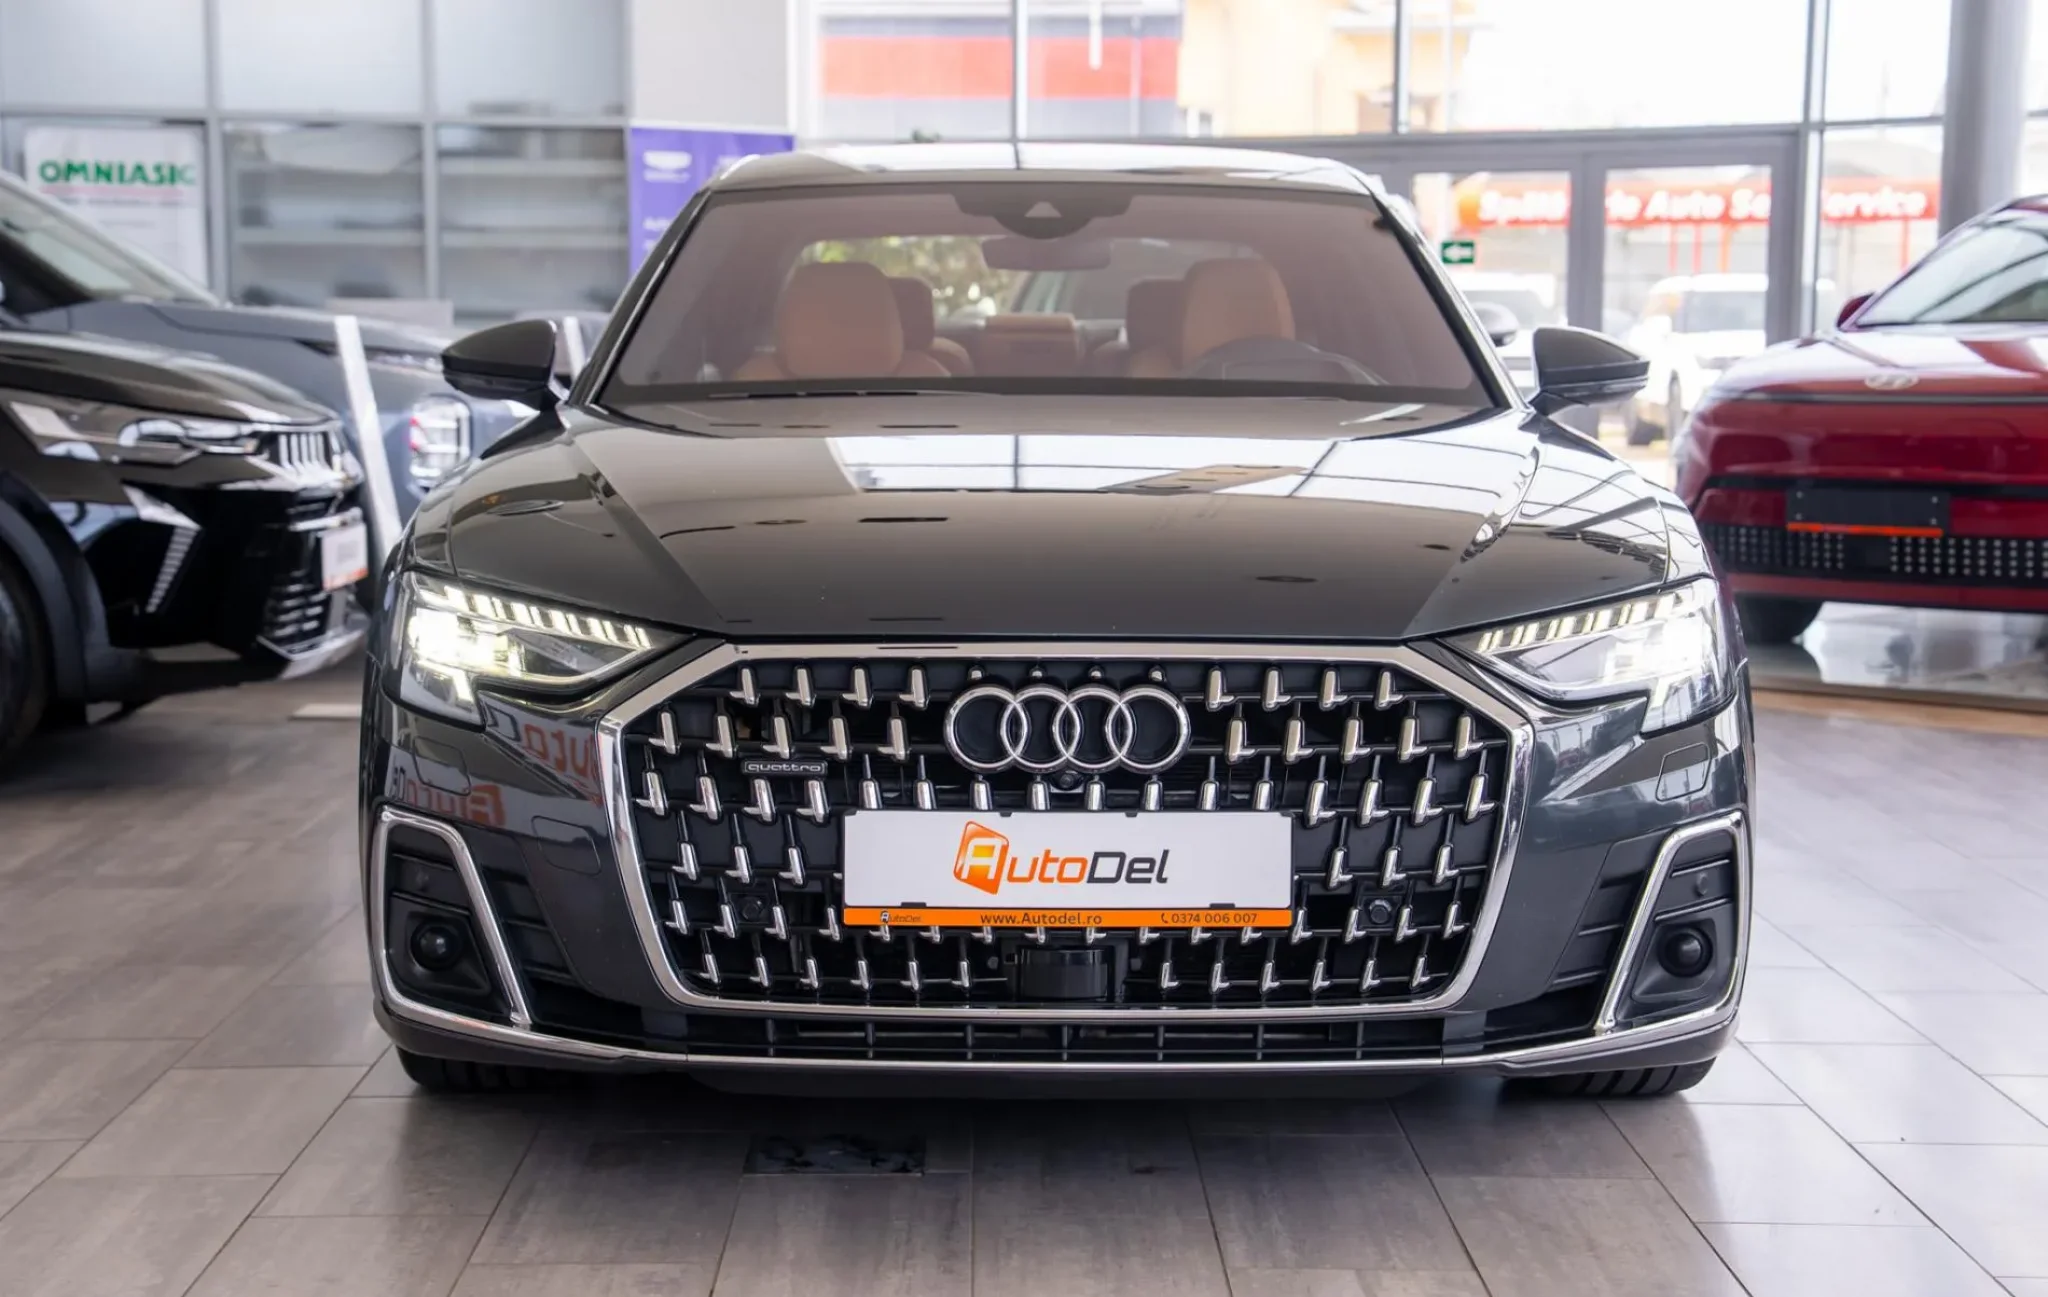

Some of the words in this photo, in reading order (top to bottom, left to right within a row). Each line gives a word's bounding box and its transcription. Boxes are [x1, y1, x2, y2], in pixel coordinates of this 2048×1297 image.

[748, 763, 821, 773] quattro
[956, 833, 1170, 888] AutoDel
[980, 912, 1103, 925] www.Autodel.ro
[1171, 913, 1201, 923] 0374
[1204, 913, 1230, 923] 006
[1233, 913, 1258, 923] 007
